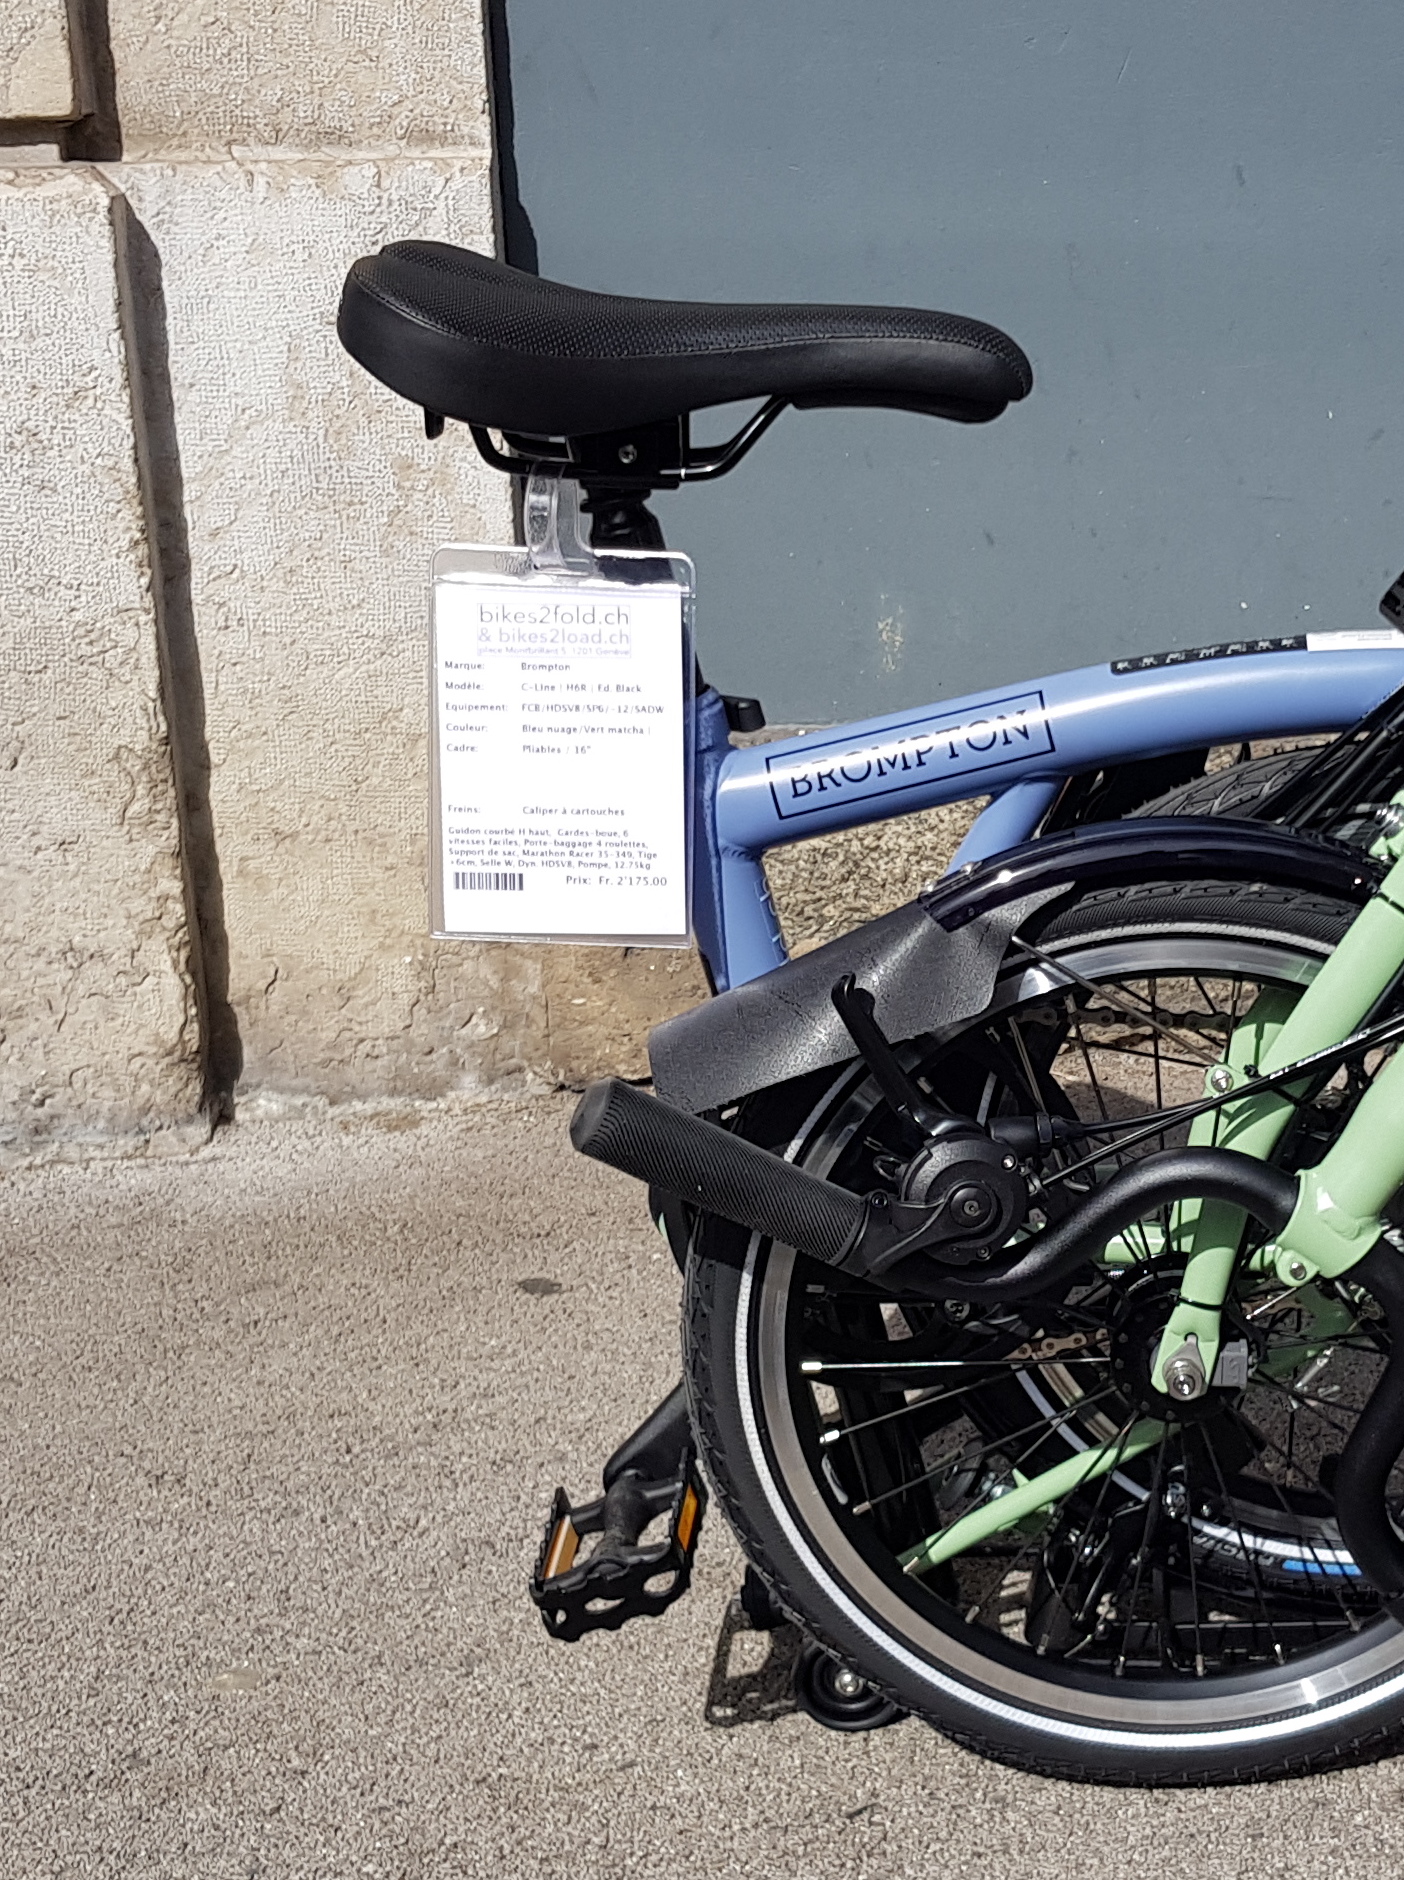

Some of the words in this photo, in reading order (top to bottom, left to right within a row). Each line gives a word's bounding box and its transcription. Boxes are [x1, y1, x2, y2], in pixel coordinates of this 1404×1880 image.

[480, 604, 629, 625] bikes2fold.ch
[478, 628, 492, 641] &
[499, 628, 629, 644] bikes2load.ch
[445, 661, 484, 670] Marque:
[521, 662, 571, 672] Brompton
[616, 684, 641, 692] Black
[608, 726, 644, 734] matcha
[446, 744, 478, 752] Cadre:
[523, 745, 561, 754] Pliables
[790, 709, 1030, 799] BROMPTON
[448, 805, 480, 814] Freins:
[523, 806, 558, 816] Caliper
[562, 807, 567, 815] à
[571, 808, 625, 816] cartouches
[489, 838, 520, 847] faciles,
[524, 840, 593, 848] Porte-baggage
[449, 848, 484, 857] Support
[638, 851, 657, 860] Tige
[480, 859, 501, 867] Selle
[566, 876, 592, 885] Prix:
[599, 876, 614, 885] Fr.
[617, 878, 667, 886] 2'175.00
